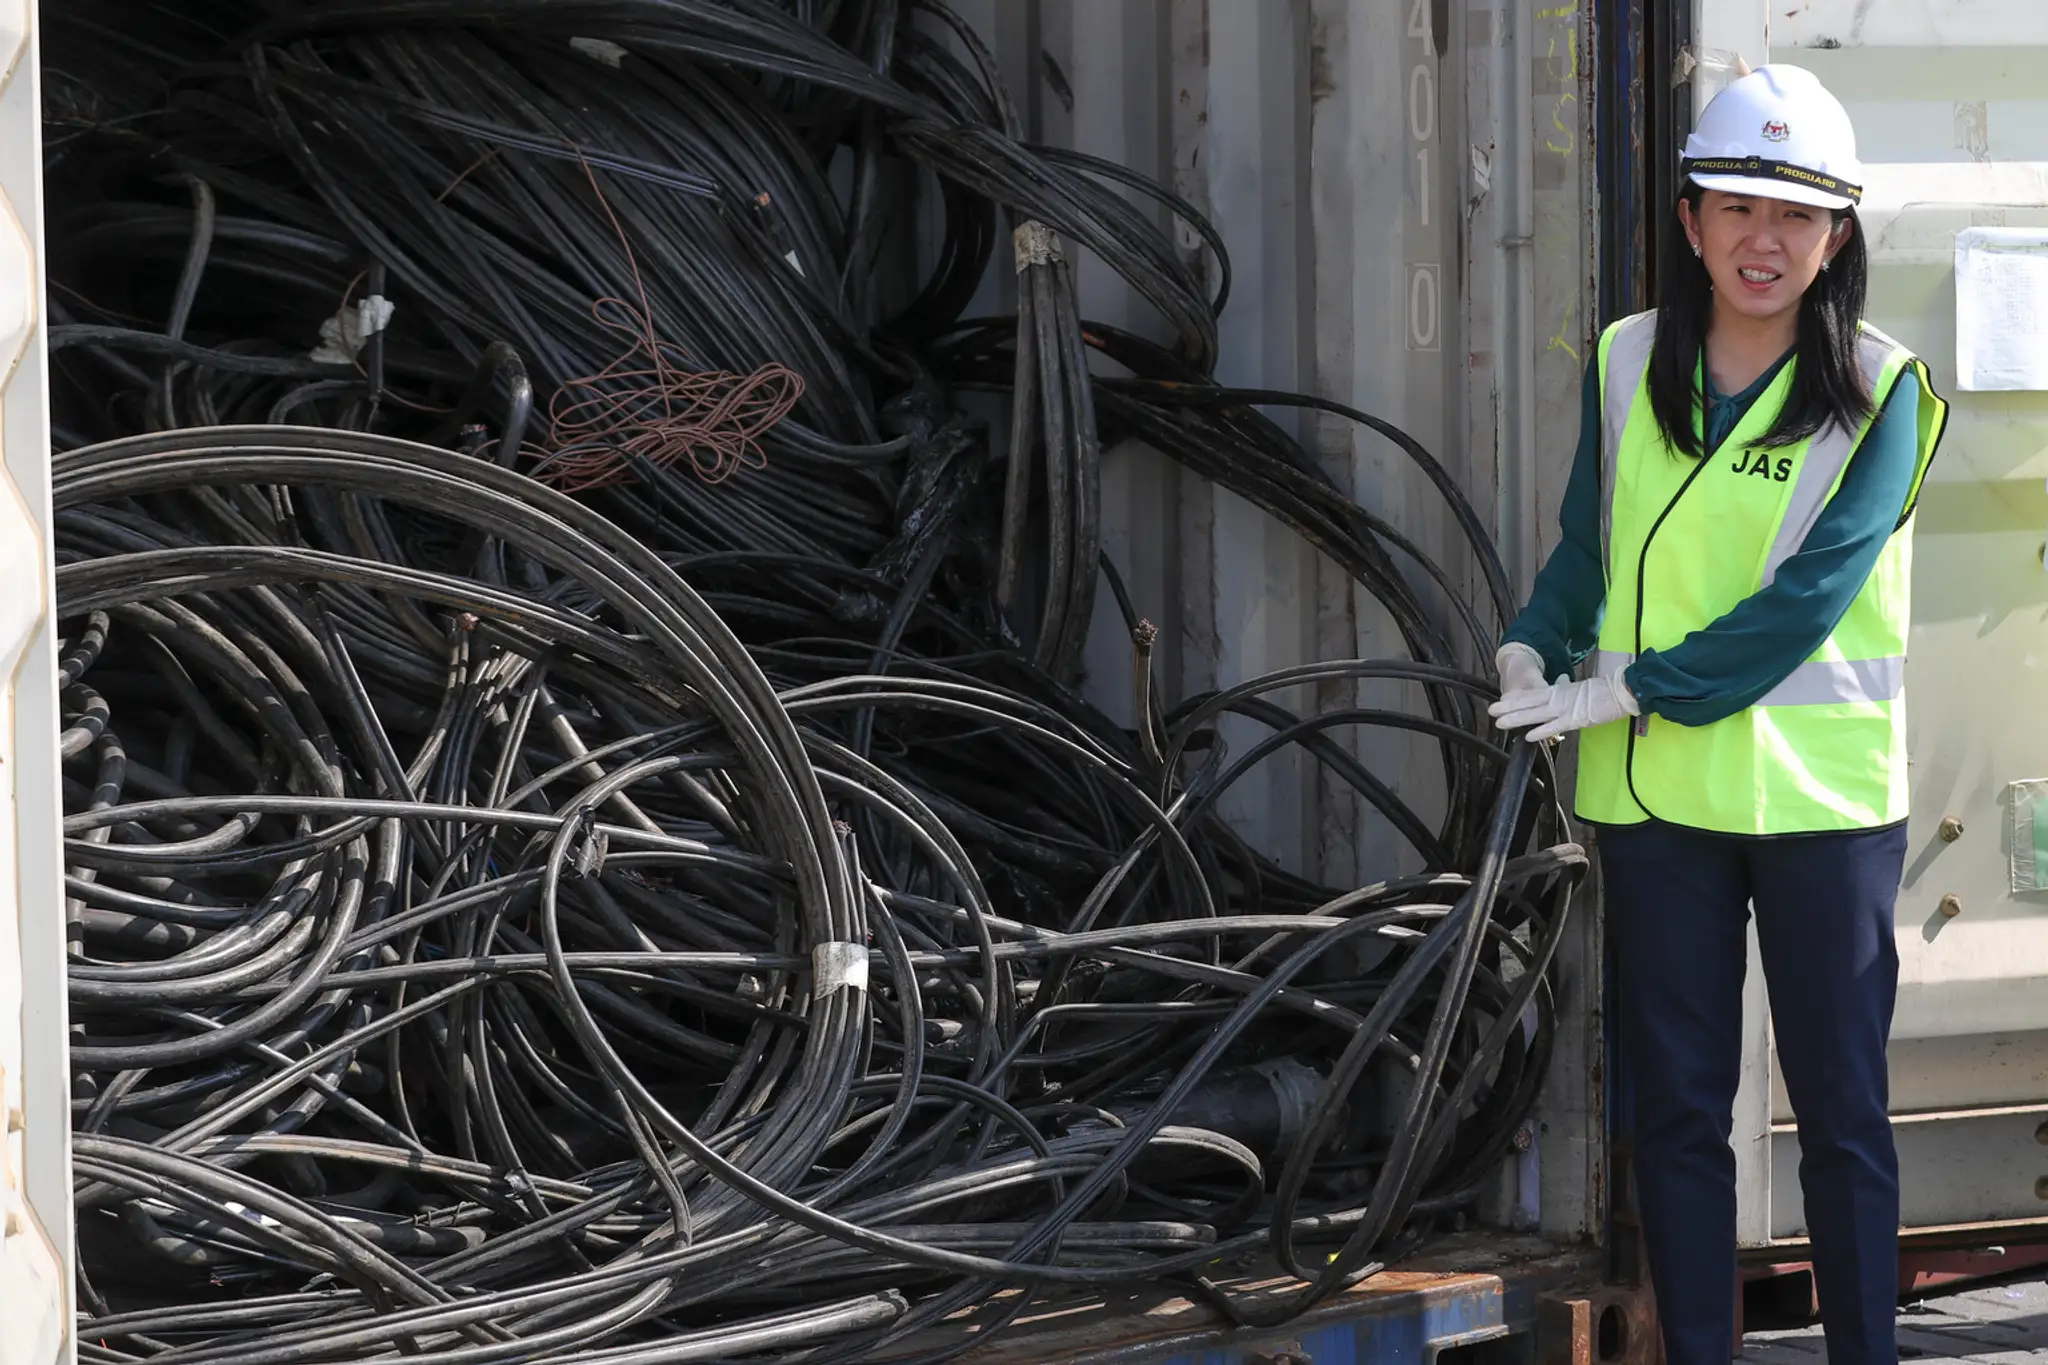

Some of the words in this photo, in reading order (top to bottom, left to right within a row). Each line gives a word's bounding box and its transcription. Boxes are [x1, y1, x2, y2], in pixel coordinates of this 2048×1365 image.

[1692, 161, 1760, 170] PROGUAD
[1774, 165, 1836, 189] PROGUARD
[1731, 449, 1793, 483] JAS
